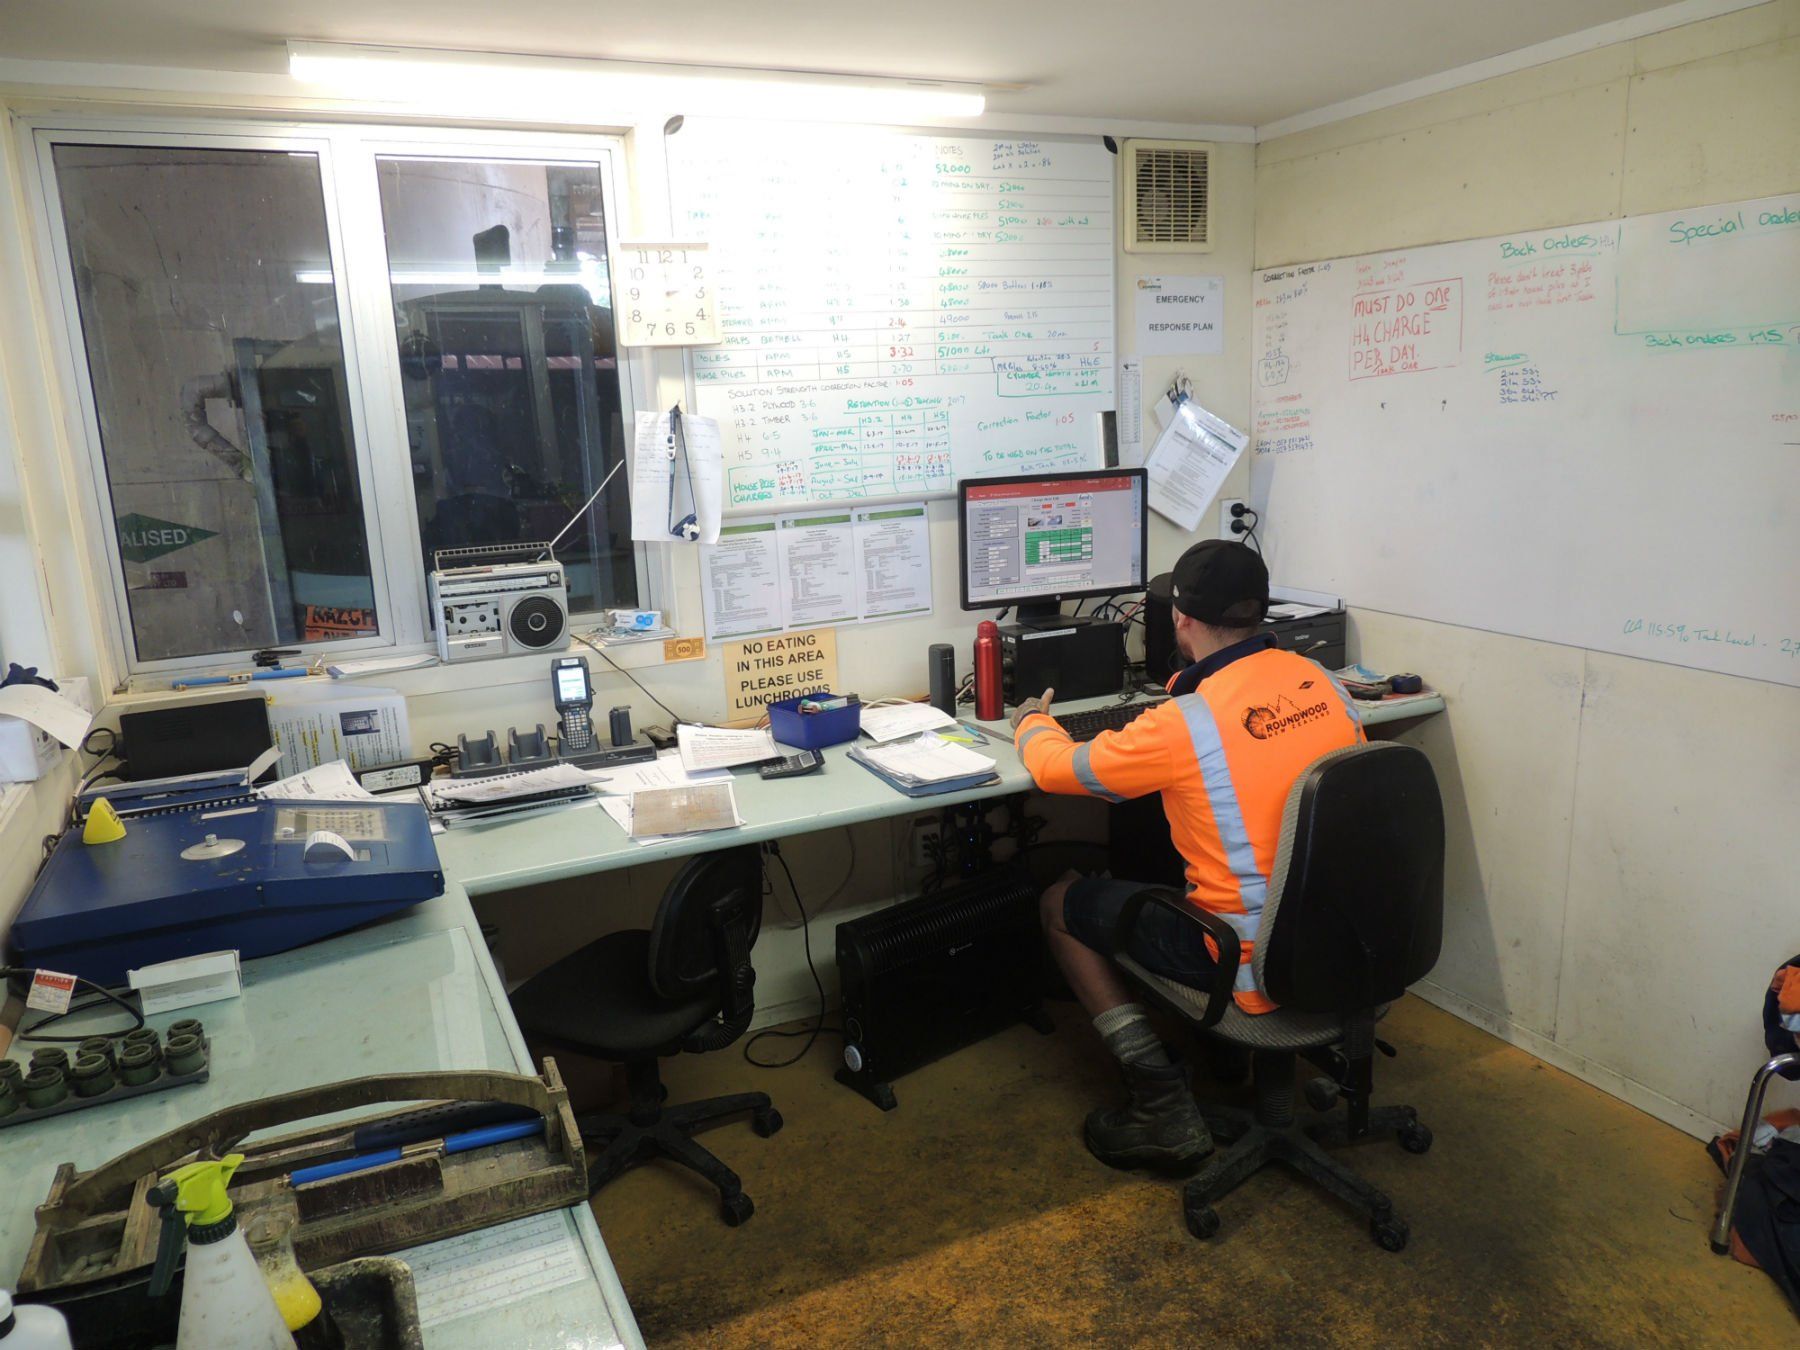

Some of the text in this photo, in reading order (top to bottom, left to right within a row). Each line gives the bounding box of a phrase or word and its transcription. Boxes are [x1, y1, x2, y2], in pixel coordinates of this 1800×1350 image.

[935, 163, 971, 174] 52000
[1669, 211, 1744, 246] Special
[1500, 240, 1537, 259] Back
[1543, 234, 1598, 250] Orders
[657, 249, 673, 264] 12
[681, 249, 688, 264] 1
[629, 267, 645, 281] 10
[693, 266, 704, 280] 2
[630, 287, 640, 301] 9
[695, 286, 705, 300] 3
[1155, 295, 1205, 305] EMERGENCY
[1354, 295, 1391, 318] MUST
[1396, 292, 1415, 313] DO
[632, 309, 642, 323] 8
[695, 307, 707, 321] 4
[939, 313, 970, 324] 49000
[646, 323, 657, 337] 7
[665, 322, 676, 336] 6
[685, 322, 695, 336] 5
[1148, 322, 1213, 332] RESPONSE PLAN
[1353, 311, 1431, 346] H4 CHARGE
[1353, 347, 1383, 371] PER
[766, 369, 794, 378] APM
[728, 388, 773, 399] SOLUTION
[776, 385, 818, 395] STRENGTH
[762, 400, 796, 410] PLYWOOD
[761, 414, 791, 424] TIMBER
[977, 417, 1018, 432] Correction
[1025, 410, 1052, 422] Factor
[737, 450, 753, 461] H5
[677, 645, 691, 655] 500
[743, 633, 816, 656] NO EATING
[736, 649, 825, 673] IN THIS AREA
[740, 668, 824, 692] PLEASE USE
[735, 683, 831, 709] LUNCHROOMS
[1265, 701, 1329, 733] ROUNDWOOD
[1267, 709, 1331, 739] NEW ZEALAND
